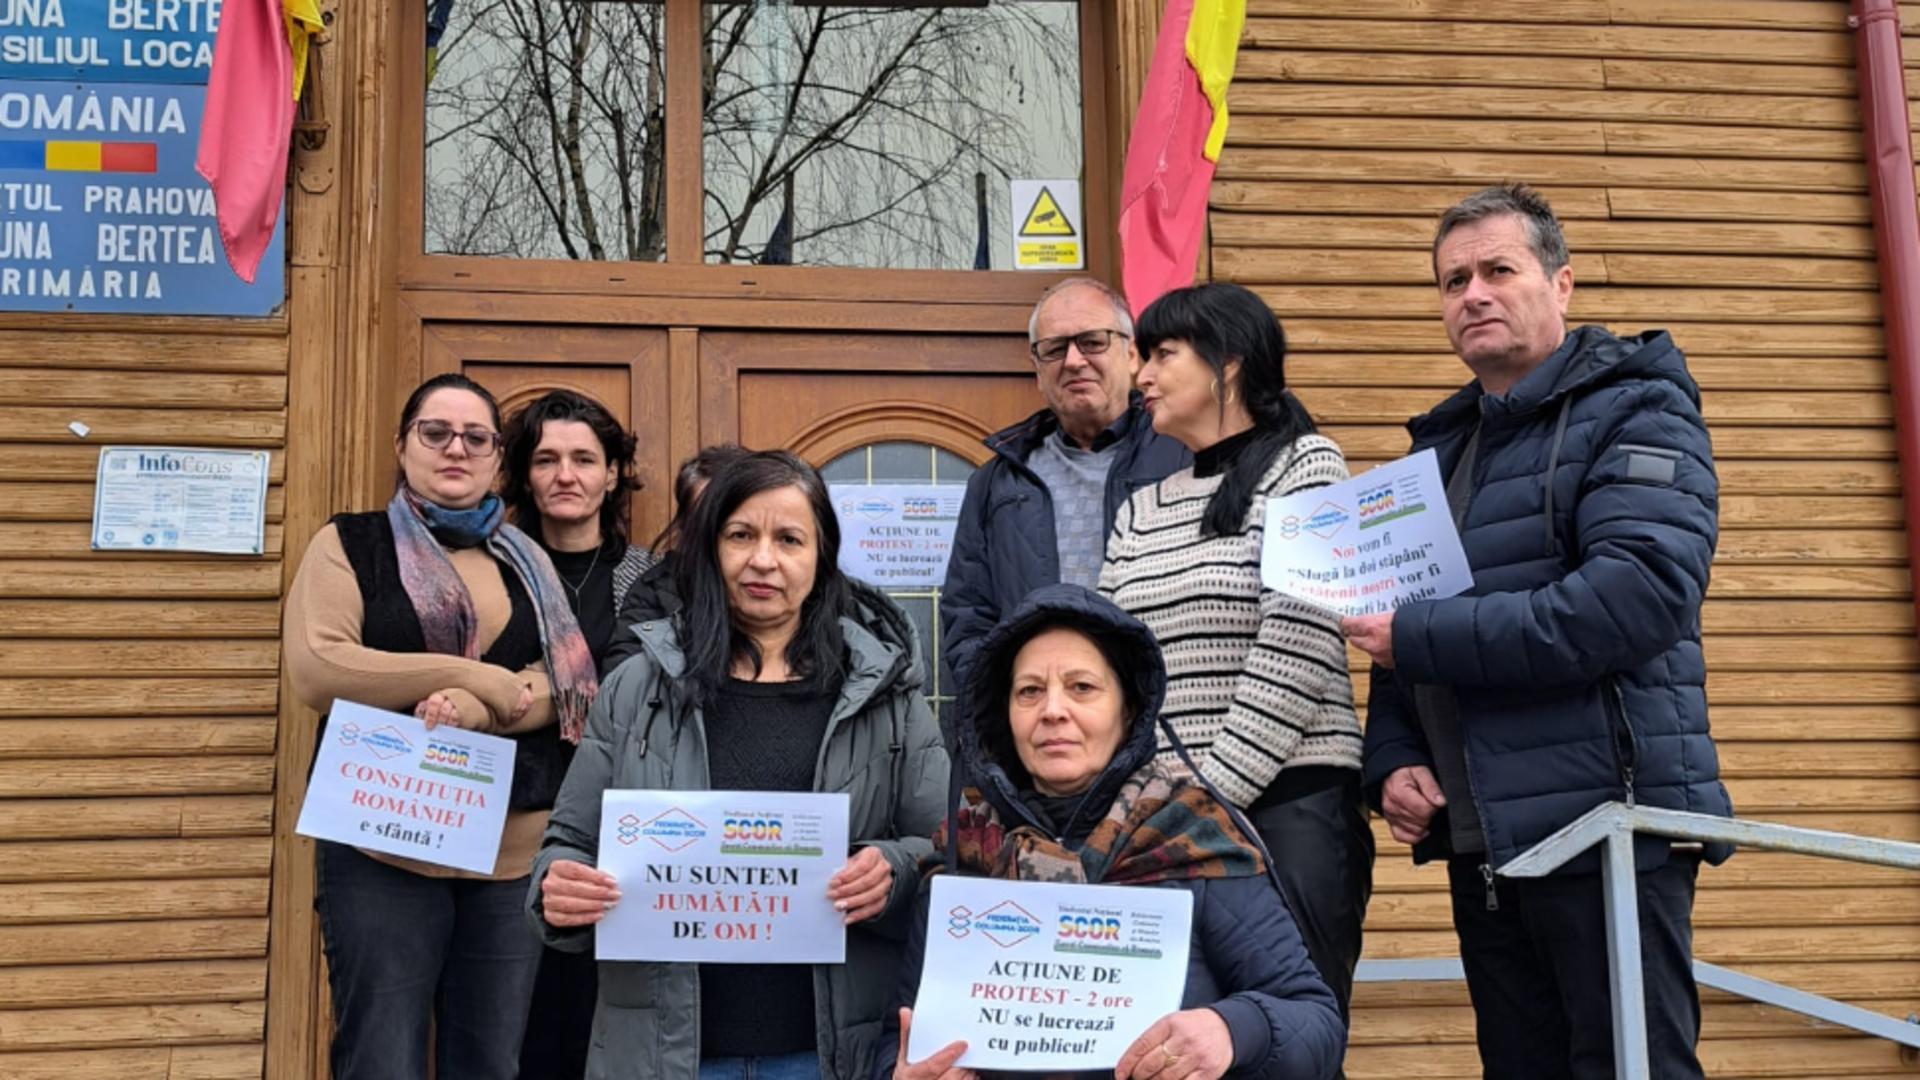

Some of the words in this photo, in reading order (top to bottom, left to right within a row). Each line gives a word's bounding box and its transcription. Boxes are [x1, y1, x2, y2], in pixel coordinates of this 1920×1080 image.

[2, 35, 109, 66] SILIUL
[84, 185, 216, 216] PRAHOVA
[98, 223, 215, 264] BERTEA
[139, 453, 232, 473] InfoCons
[1358, 489, 1394, 516] SCOR
[925, 527, 941, 536] DE
[859, 540, 913, 549] PROTEST
[1333, 546, 1355, 559] Noi
[1357, 539, 1380, 554] vom
[1383, 532, 1392, 545] fi
[866, 553, 884, 563] NU
[1344, 566, 1355, 578] la
[1359, 561, 1376, 574] doi
[874, 568, 886, 576] cu
[1399, 571, 1423, 585] vor
[1428, 563, 1441, 577] fi
[424, 743, 471, 767] SCOR
[340, 762, 486, 809] CONSTITUȚIA
[352, 789, 466, 829] ROMÂNIEI
[360, 820, 370, 832] e
[375, 821, 431, 846] sfântă
[436, 833, 444, 849] !
[723, 819, 782, 841] SCOR
[645, 863, 682, 883] NU
[690, 865, 799, 886] SUNTEM
[653, 890, 789, 917] JUMĂTĂȚI
[673, 921, 706, 939] DE
[714, 923, 757, 940] OM
[765, 923, 772, 940] !
[1058, 914, 1121, 940] SCOR
[988, 960, 1086, 982] ACȚIUNE
[1092, 966, 1122, 984] DE
[970, 982, 1070, 1006] PROTEST
[1087, 991, 1098, 1007] 2
[1102, 996, 1133, 1008] ore
[978, 1007, 1010, 1025] NU
[1014, 1015, 1033, 1028] se
[1038, 1012, 1115, 1032] lucrează
[988, 1037, 1009, 1051] cu
[1014, 1039, 1097, 1056] publicul!
